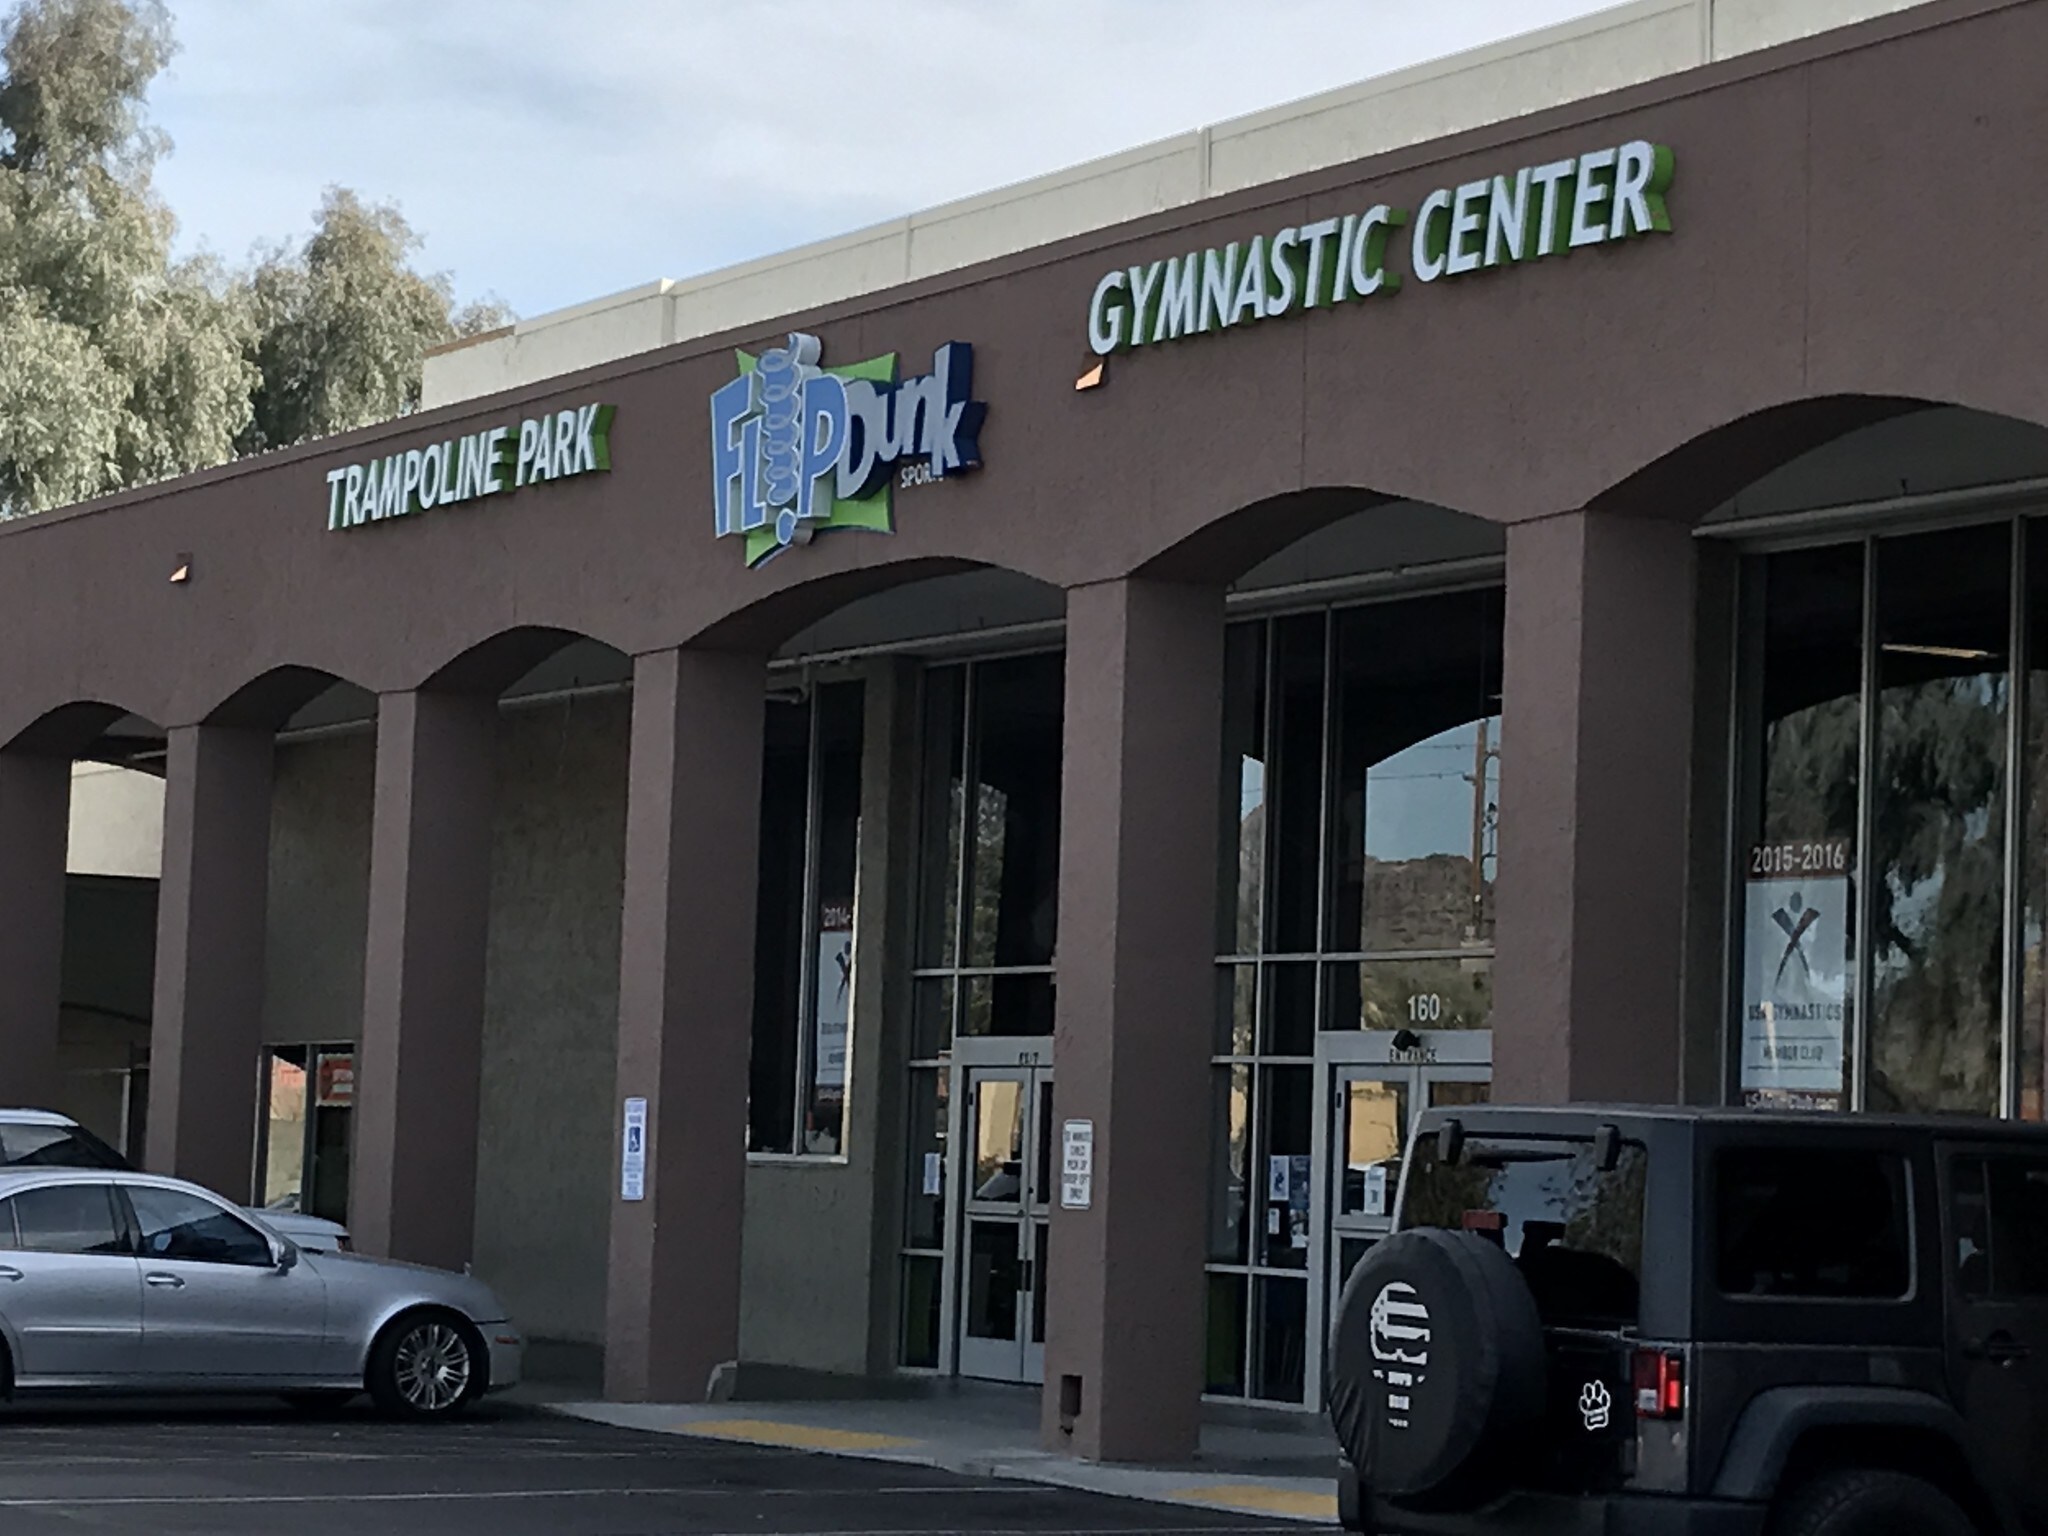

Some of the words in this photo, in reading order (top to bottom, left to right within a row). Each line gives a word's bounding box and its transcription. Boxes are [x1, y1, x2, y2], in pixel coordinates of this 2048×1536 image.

[1088, 205, 1392, 356] GYMNASTIC
[1412, 140, 1657, 282] CENTER
[326, 425, 510, 532] TRAMPOLINE
[514, 402, 602, 487] PARK
[1752, 843, 1845, 873] 2015-2016
[1407, 993, 1441, 1022] 160
